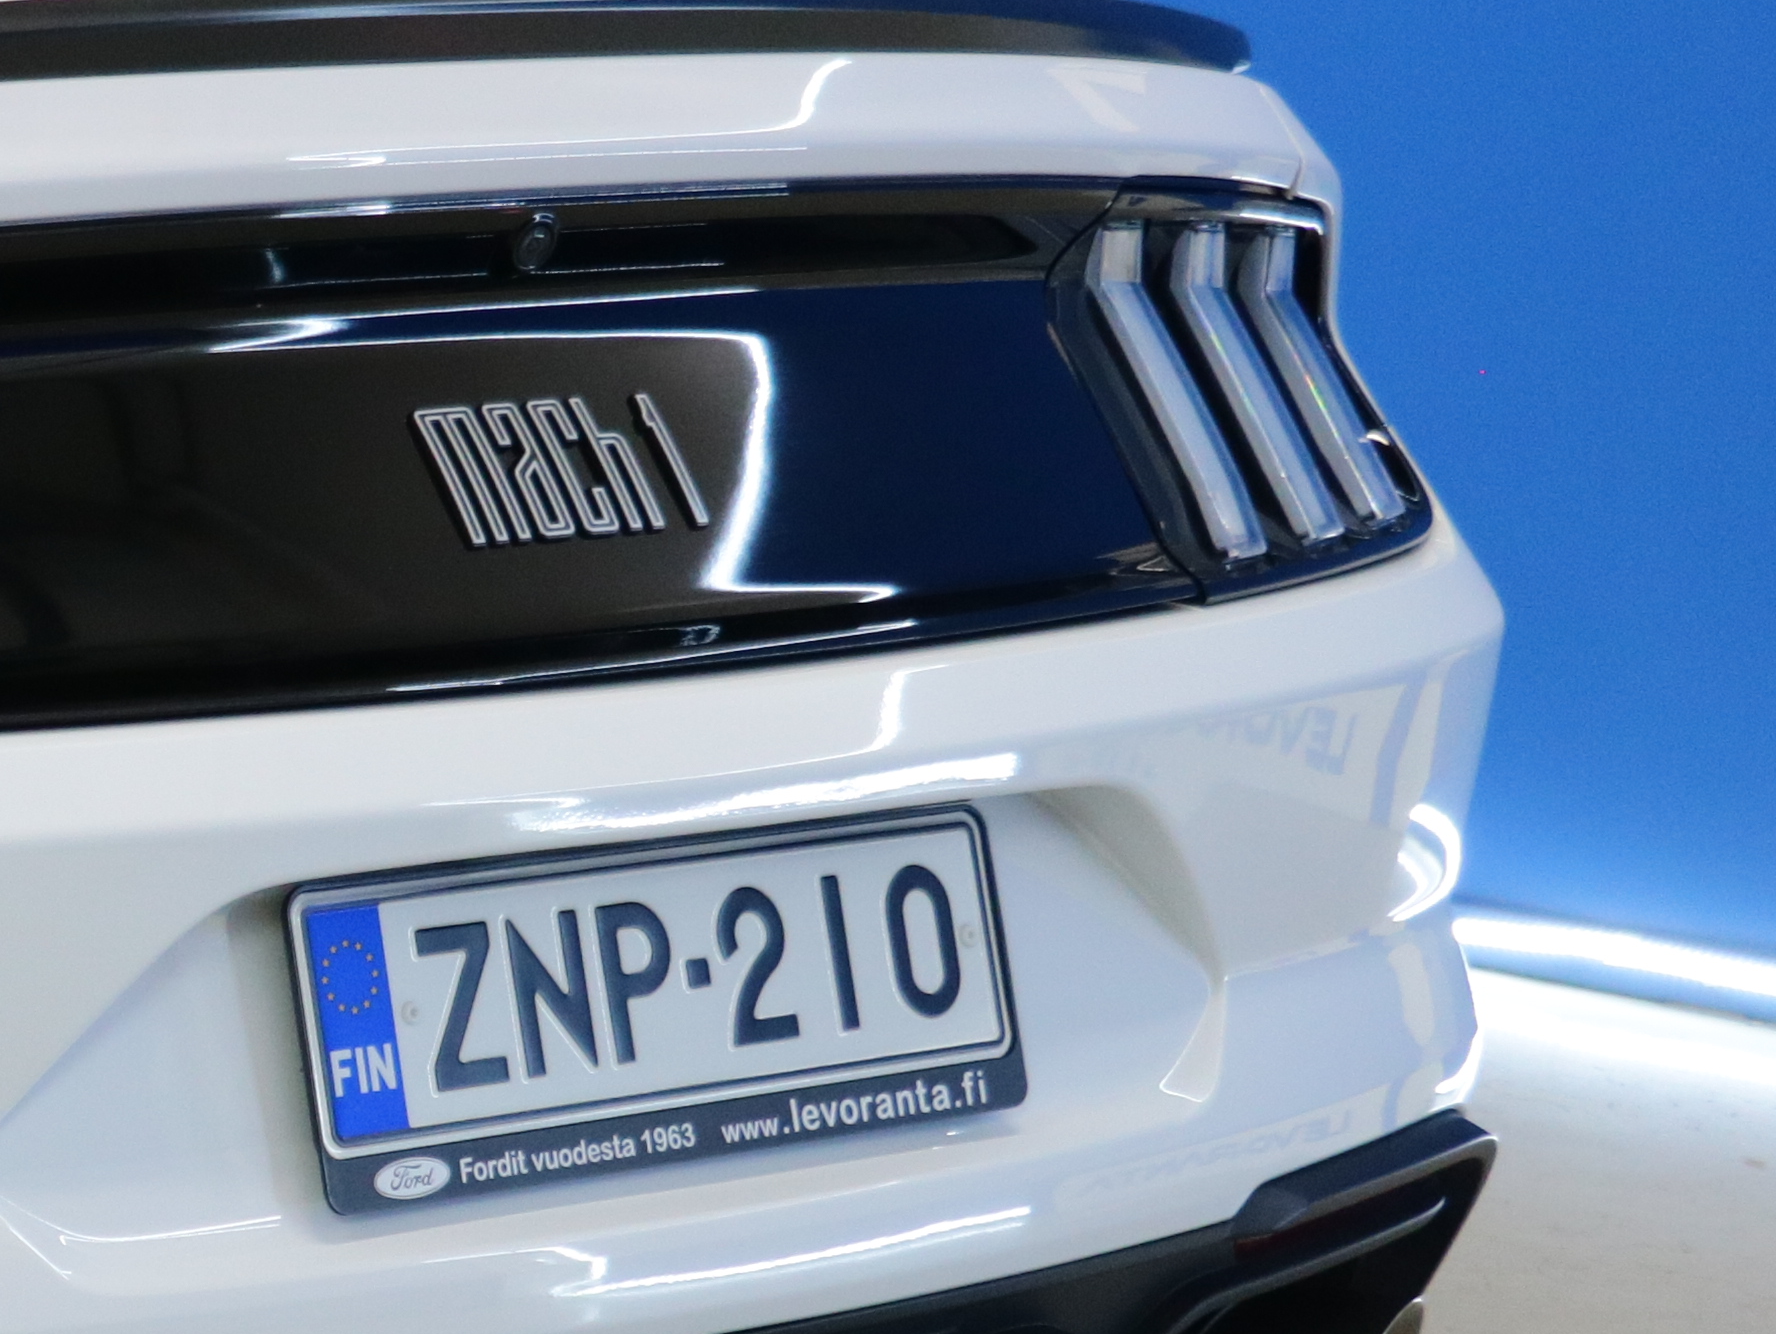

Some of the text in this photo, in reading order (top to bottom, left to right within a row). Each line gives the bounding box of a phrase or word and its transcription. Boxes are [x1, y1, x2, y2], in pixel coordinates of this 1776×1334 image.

[633, 392, 709, 527] 1
[411, 863, 963, 1094] ZNP-210
[329, 1042, 399, 1098] FIN
[459, 1070, 989, 1184] Fordit vuodesta 1963 www.levoranta.fi
[389, 1163, 435, 1192] Ford
